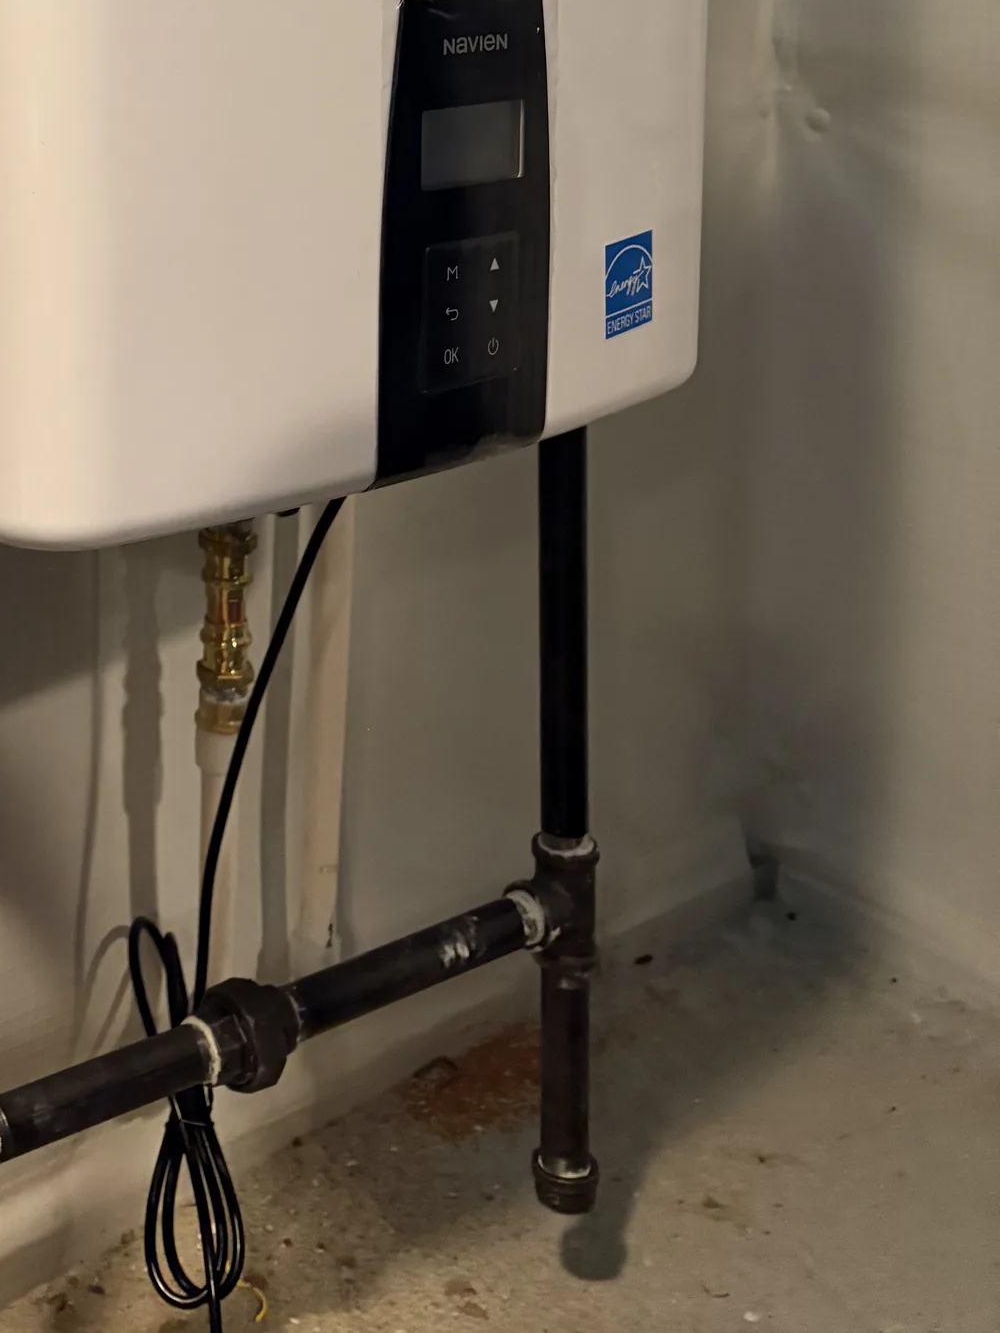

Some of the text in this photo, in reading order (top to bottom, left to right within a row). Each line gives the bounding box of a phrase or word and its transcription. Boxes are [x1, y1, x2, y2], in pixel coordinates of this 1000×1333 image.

[446, 265, 458, 281] M
[607, 305, 651, 334] ENERGY STAR
[443, 347, 459, 364] OK
